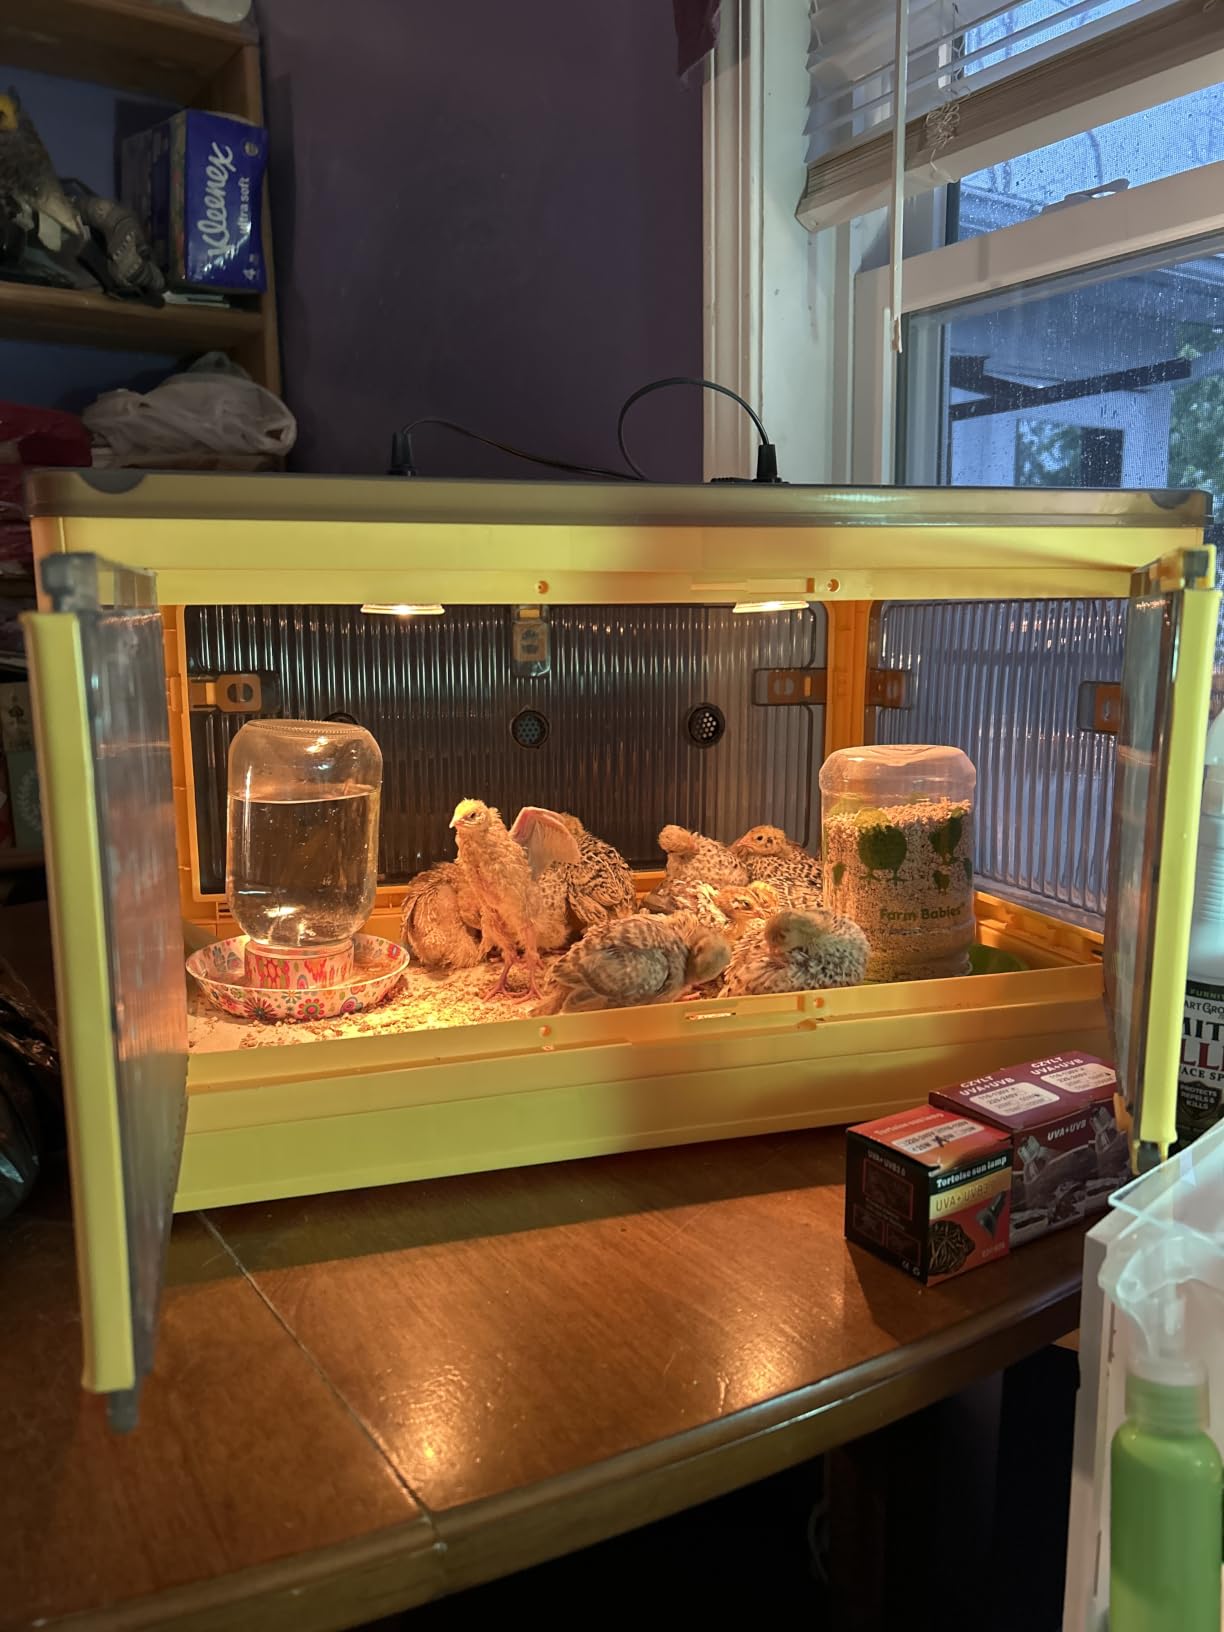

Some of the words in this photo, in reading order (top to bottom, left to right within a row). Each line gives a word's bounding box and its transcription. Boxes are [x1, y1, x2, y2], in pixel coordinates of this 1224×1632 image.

[198, 142, 236, 258] Kleenex
[238, 177, 250, 201] soft
[237, 203, 251, 234] ultra
[879, 908, 917, 921] Farm
[920, 906, 961, 920] Babies
[1190, 988, 1224, 1001] FURNI
[1047, 1119, 1087, 1141] UVA+UVB
[936, 1171, 972, 1188] Tortoise
[972, 1164, 987, 1176] sun
[987, 1156, 1007, 1171] lamp
